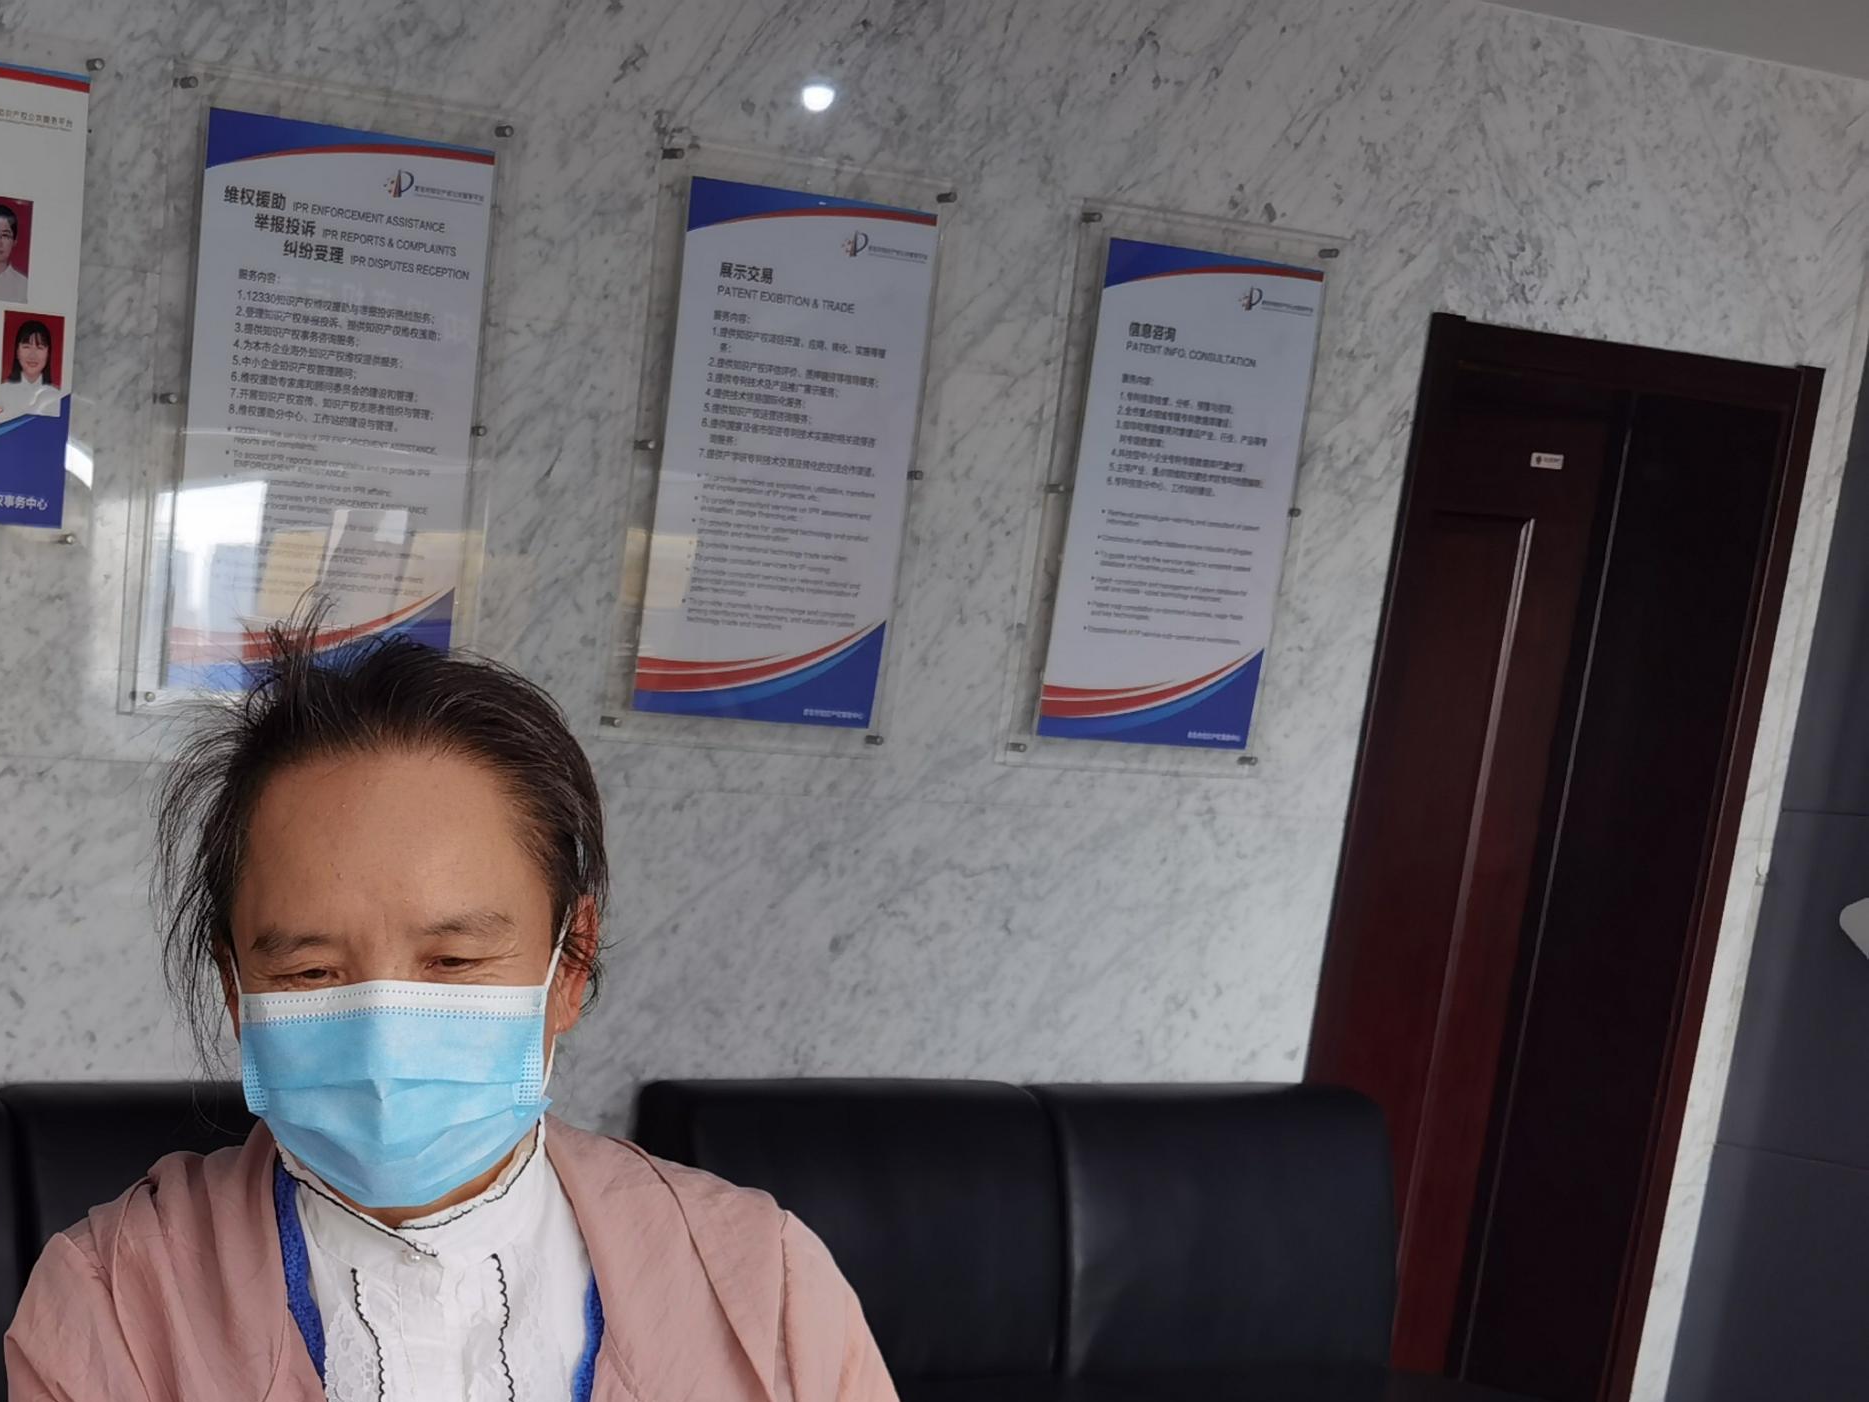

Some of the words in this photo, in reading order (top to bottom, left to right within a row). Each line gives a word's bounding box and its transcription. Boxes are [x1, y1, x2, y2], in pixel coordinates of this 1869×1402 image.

[224, 185, 287, 211] 维权援助
[254, 213, 316, 238] 举报投诉
[292, 202, 309, 213] IPR
[311, 204, 384, 225] ENFORCEMENT
[386, 214, 446, 233] ASSISTANCE
[284, 240, 344, 265] 纠纷受理
[322, 228, 338, 240] IPR
[340, 231, 385, 247] REPORTS
[387, 237, 394, 248] &
[396, 239, 457, 257] COMPLAINTS
[350, 255, 366, 266] IPR
[368, 257, 414, 274] DISPUTES
[416, 263, 470, 281] RECEPTION
[719, 261, 774, 285] 展示交易
[717, 285, 759, 300] PATENT
[811, 299, 819, 310] &
[822, 300, 855, 314] TRADE
[1129, 321, 1177, 342] 信息咨询
[1189, 350, 1256, 368] CONSULTATION
